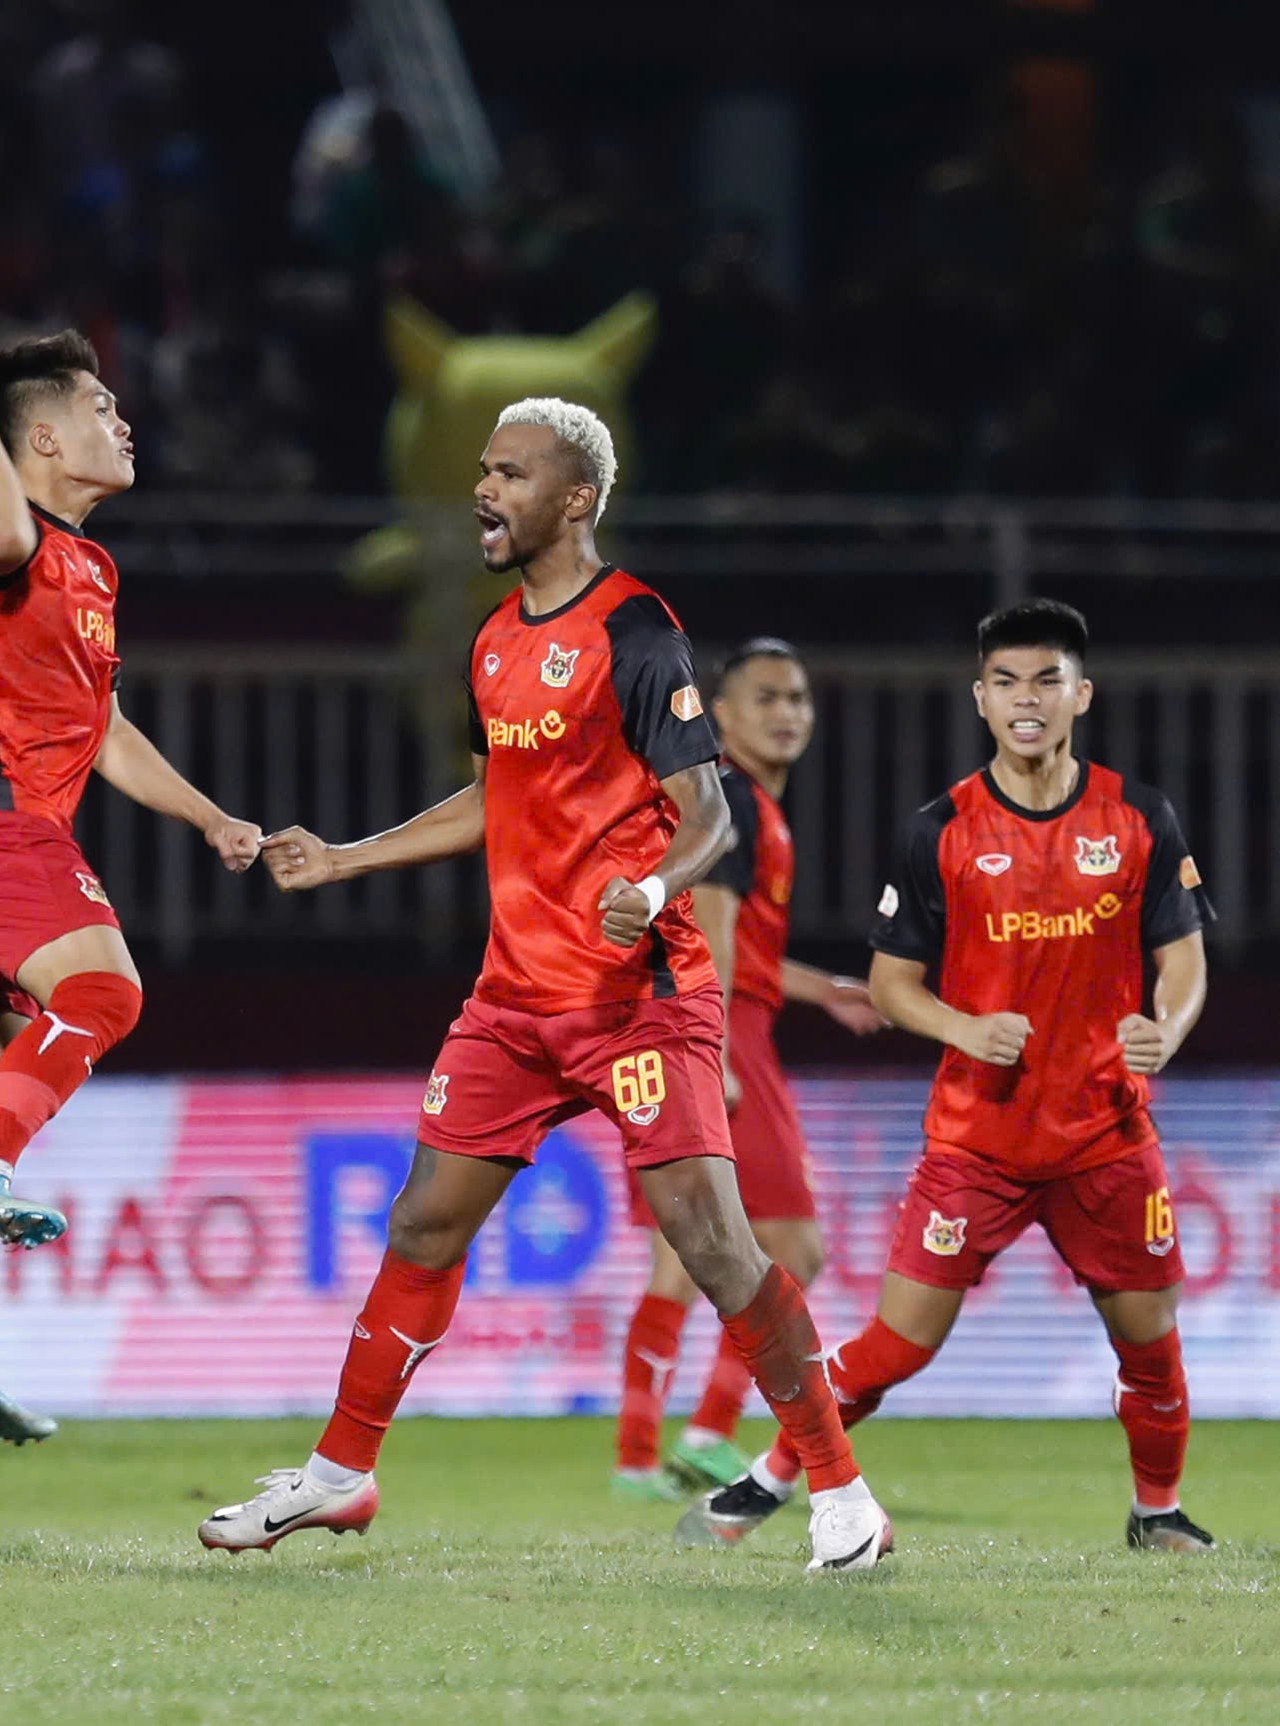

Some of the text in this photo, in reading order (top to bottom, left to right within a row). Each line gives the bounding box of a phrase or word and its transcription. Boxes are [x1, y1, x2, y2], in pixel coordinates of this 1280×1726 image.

[985, 906, 1095, 943] LPBank
[611, 1049, 667, 1113] 68
[1144, 1186, 1174, 1243] 16
